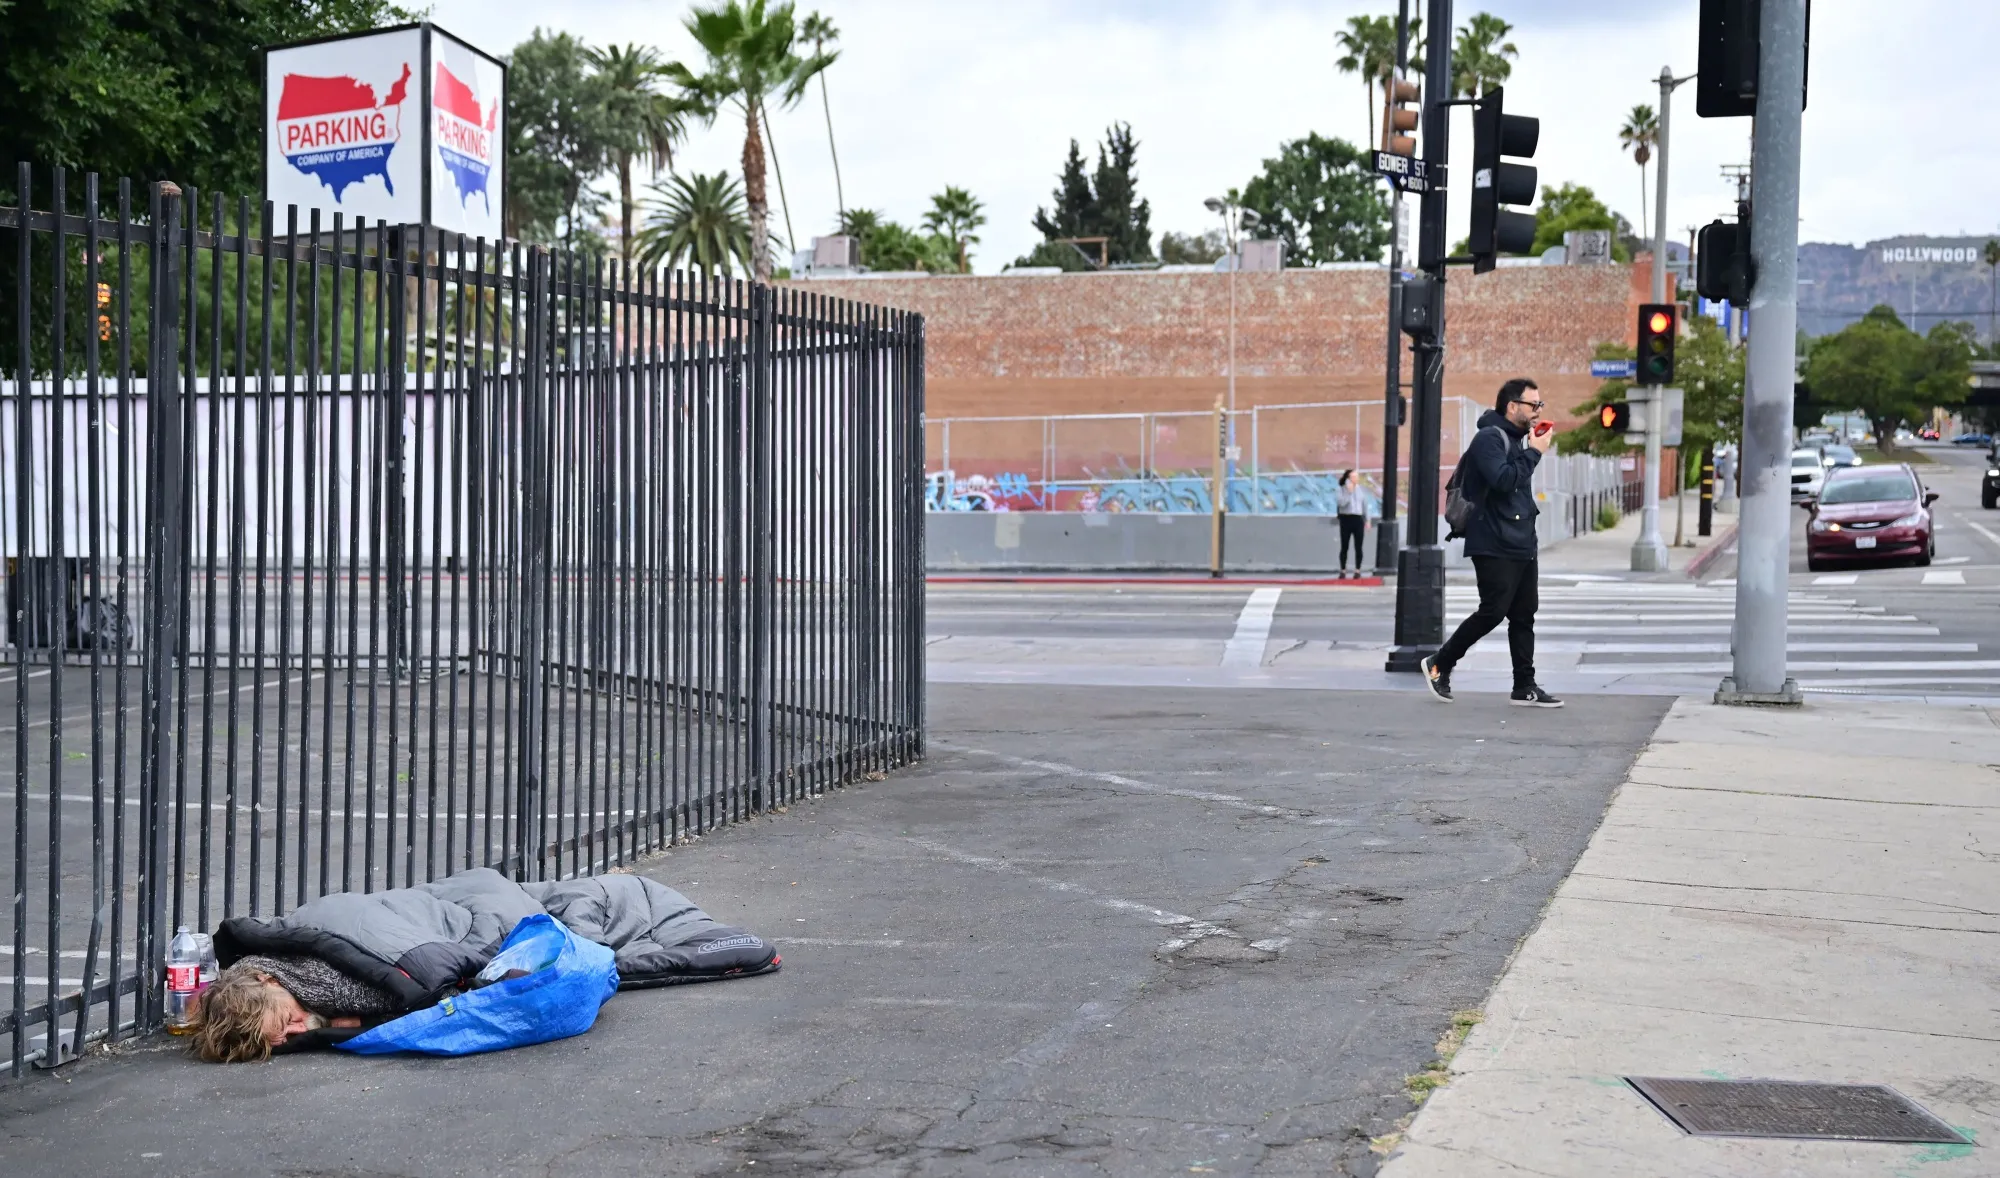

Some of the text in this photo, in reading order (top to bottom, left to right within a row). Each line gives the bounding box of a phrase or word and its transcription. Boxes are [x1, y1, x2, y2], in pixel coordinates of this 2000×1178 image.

[286, 112, 386, 150] PARKING
[438, 114, 487, 159] PARKING
[297, 146, 384, 167] COMPANY OF AMERICA
[1378, 152, 1408, 174] GOWER
[1882, 246, 1978, 263] HOLLYWOOD
[1592, 360, 1629, 373] Hollywood
[702, 936, 751, 951] Coleman
